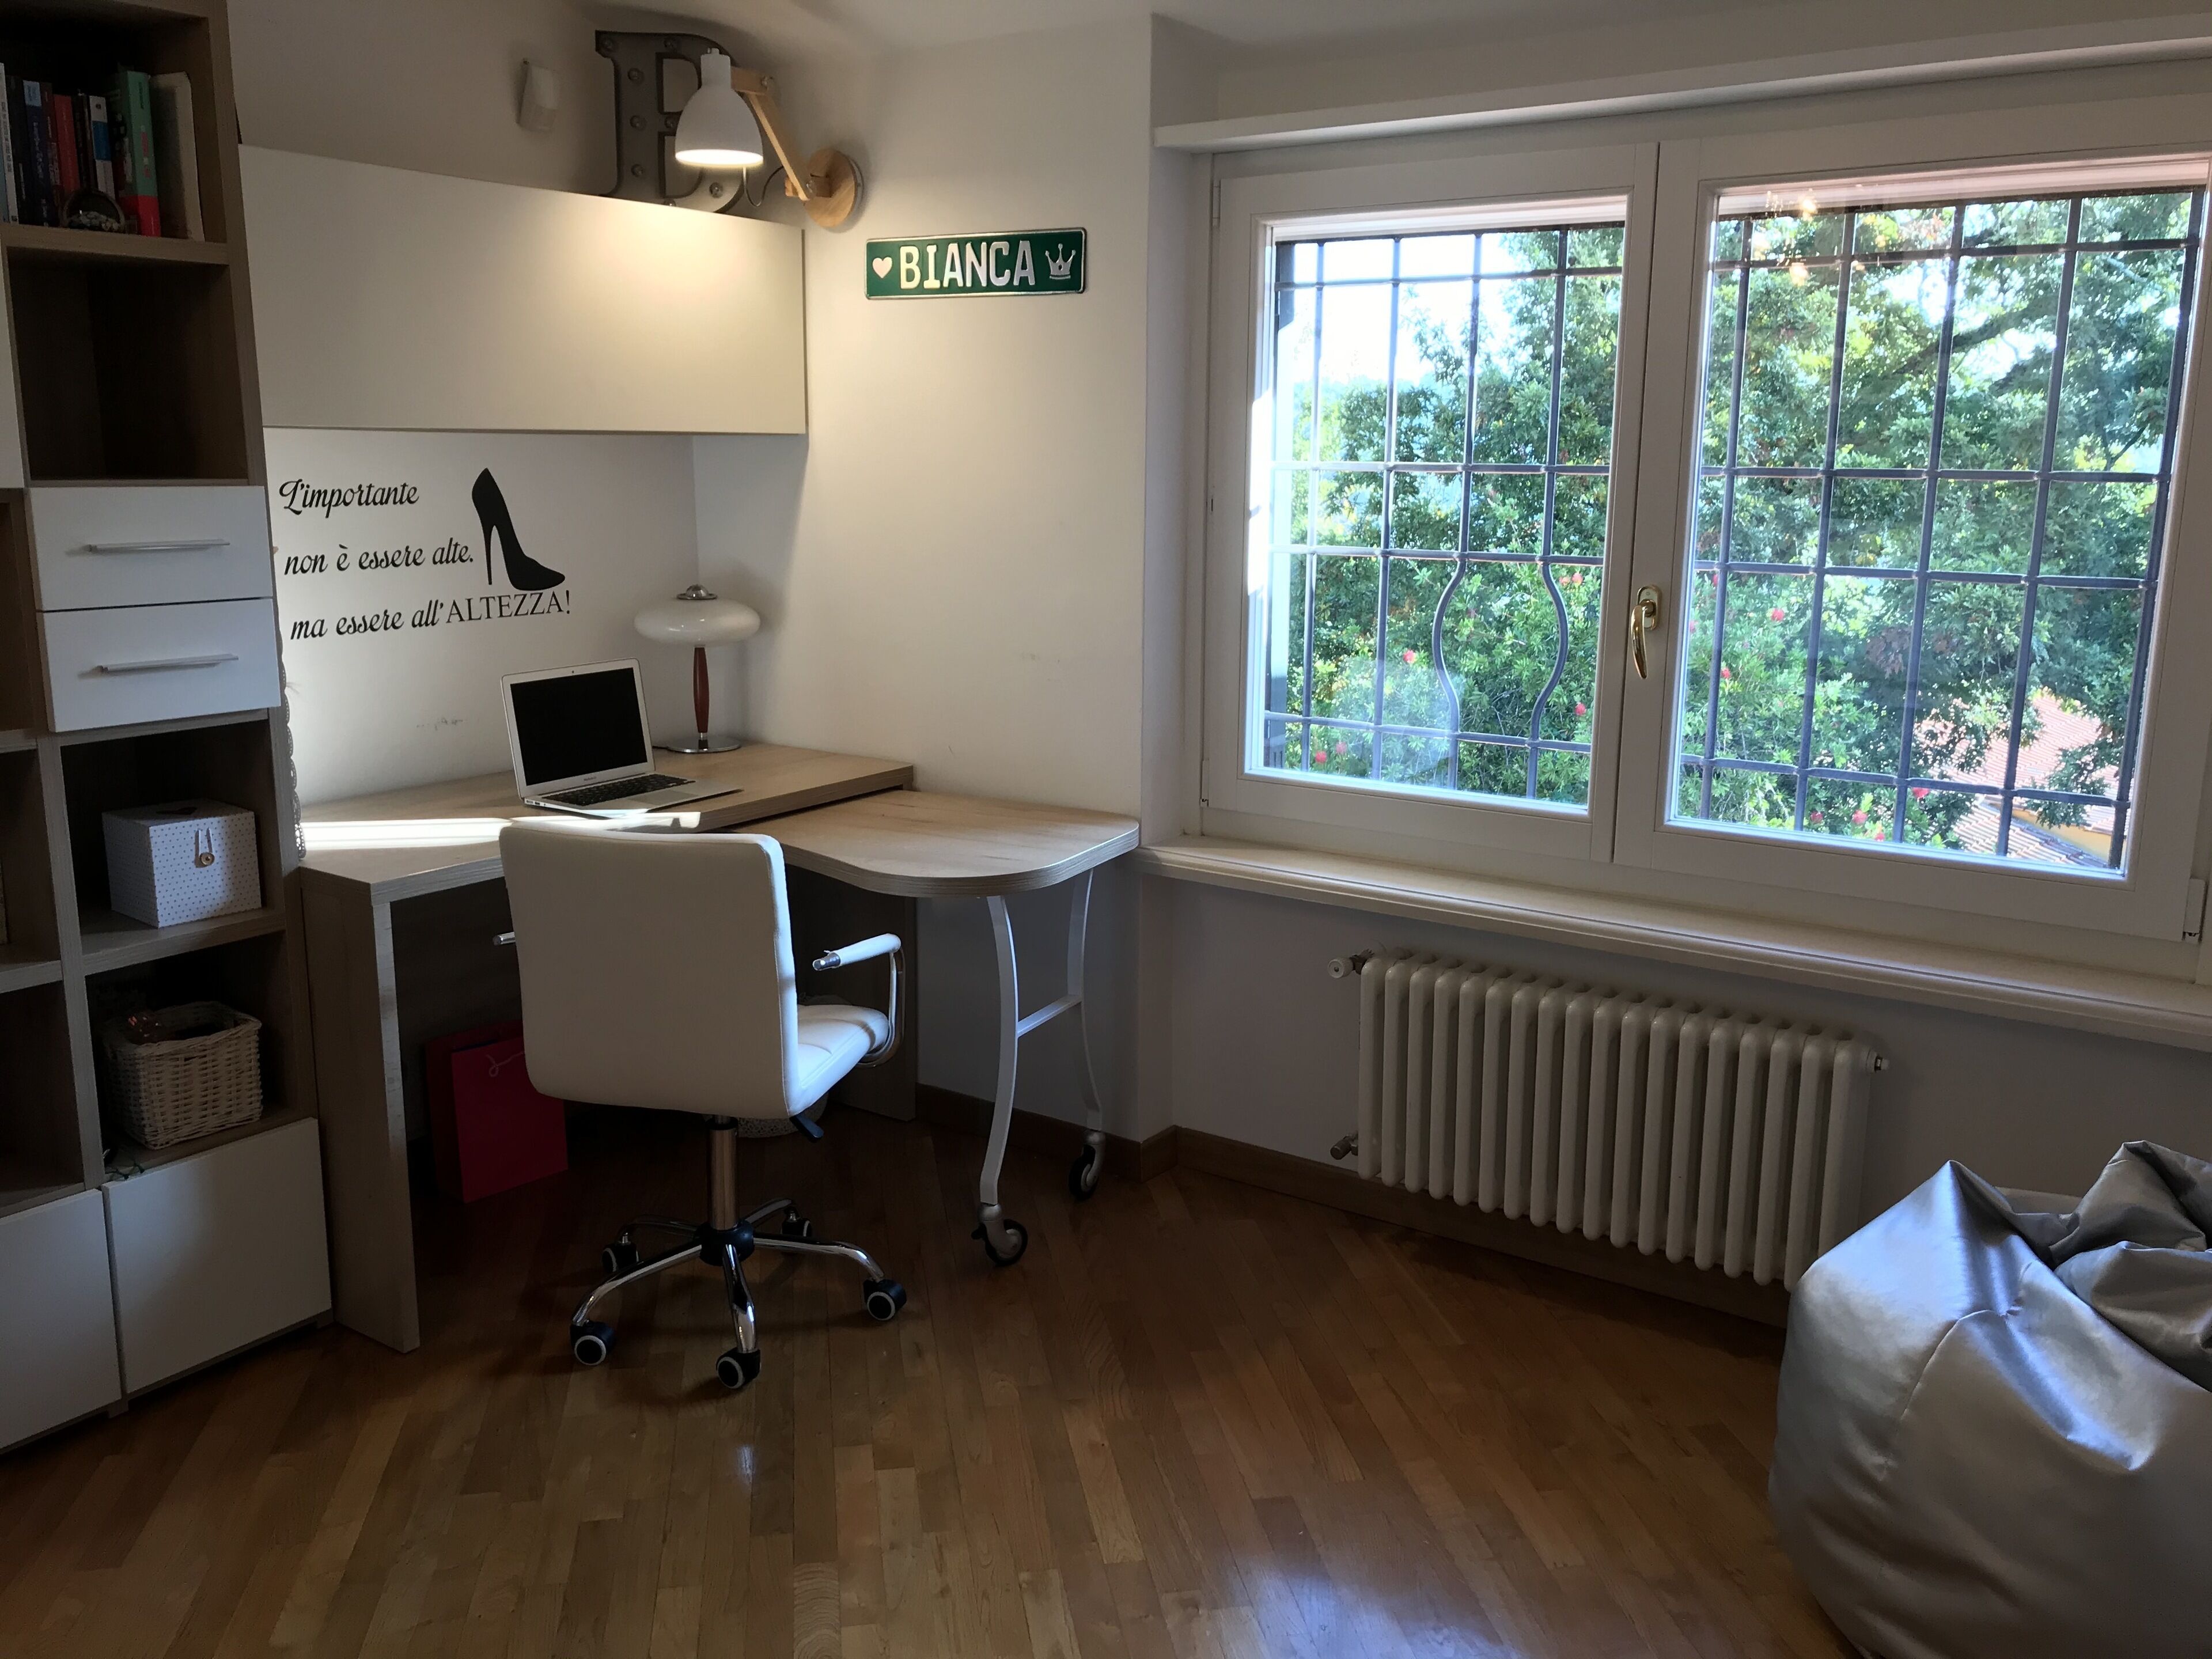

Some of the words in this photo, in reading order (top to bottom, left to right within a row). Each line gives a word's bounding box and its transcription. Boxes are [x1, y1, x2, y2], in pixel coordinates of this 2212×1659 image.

[900, 240, 1035, 289] BIANCA
[279, 478, 419, 518] L'importante
[285, 554, 328, 575] non
[337, 544, 350, 571] è
[359, 545, 425, 570] essere
[433, 537, 474, 565] alte.
[291, 619, 327, 640] ma
[336, 609, 404, 635] essere
